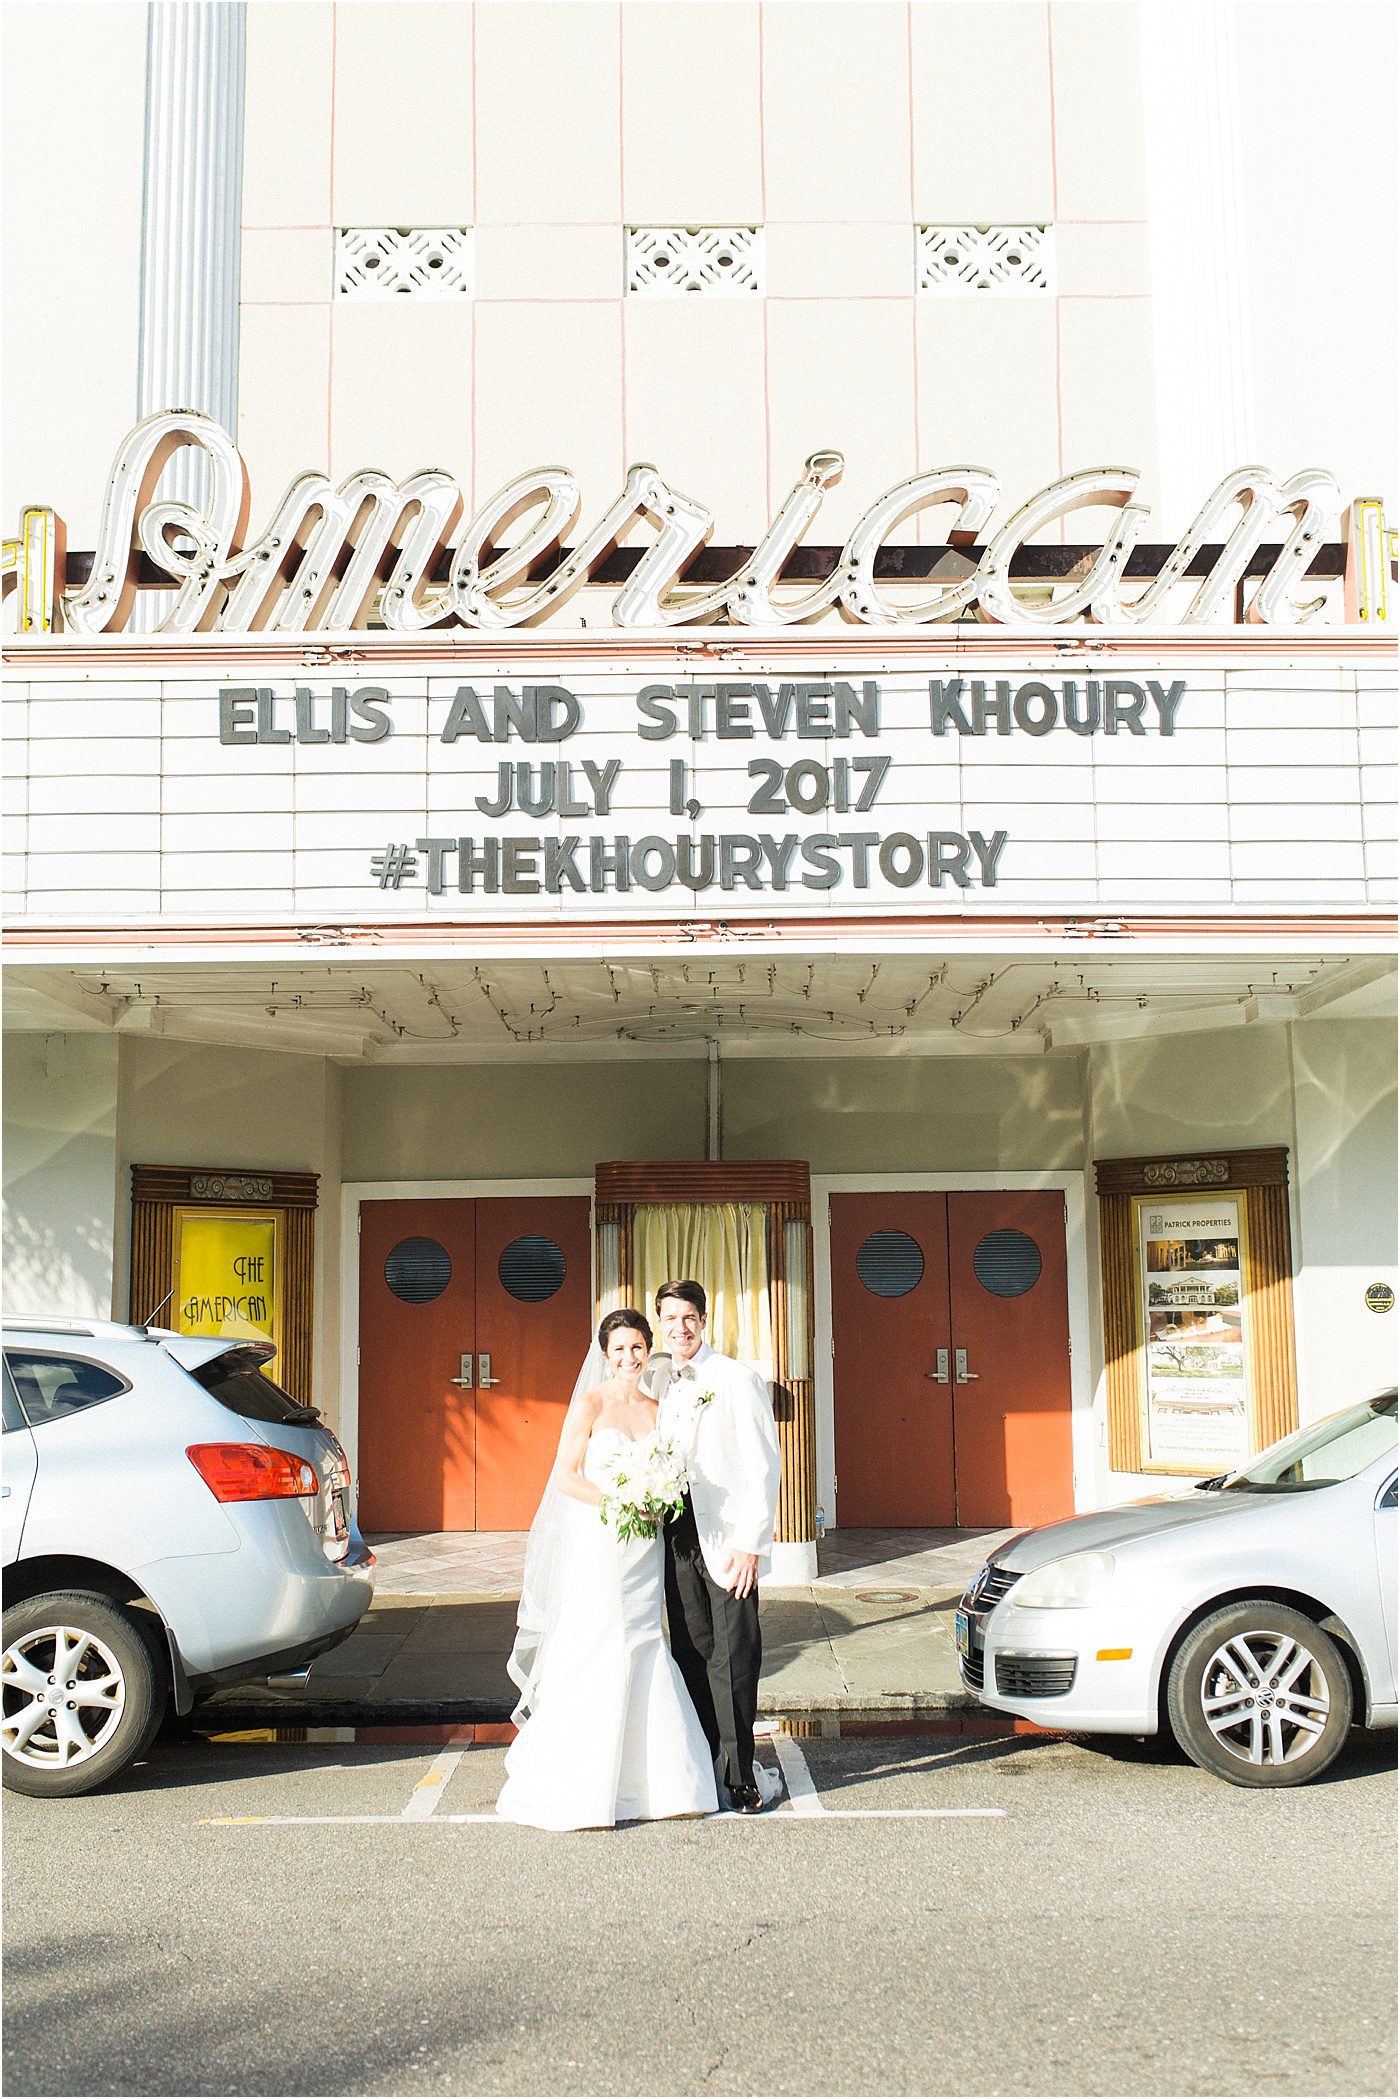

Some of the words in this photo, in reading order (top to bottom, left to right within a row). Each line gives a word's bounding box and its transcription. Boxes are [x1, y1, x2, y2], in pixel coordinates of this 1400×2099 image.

[62, 408, 1343, 633] American
[218, 686, 391, 745] ELLIS
[440, 685, 582, 743] AND
[636, 681, 879, 741] STEVEN
[928, 678, 1186, 737] KHOURY
[474, 759, 621, 818] JULY
[669, 759, 701, 821] 1,
[747, 755, 892, 815] 2017
[370, 830, 1007, 894] #THEKHOURYSTORY
[1164, 1220, 1191, 1228] PATRICK
[1192, 1218, 1231, 1227] PROPERTIES
[233, 1256, 264, 1285] THE
[184, 1295, 267, 1326] AMERICAN
